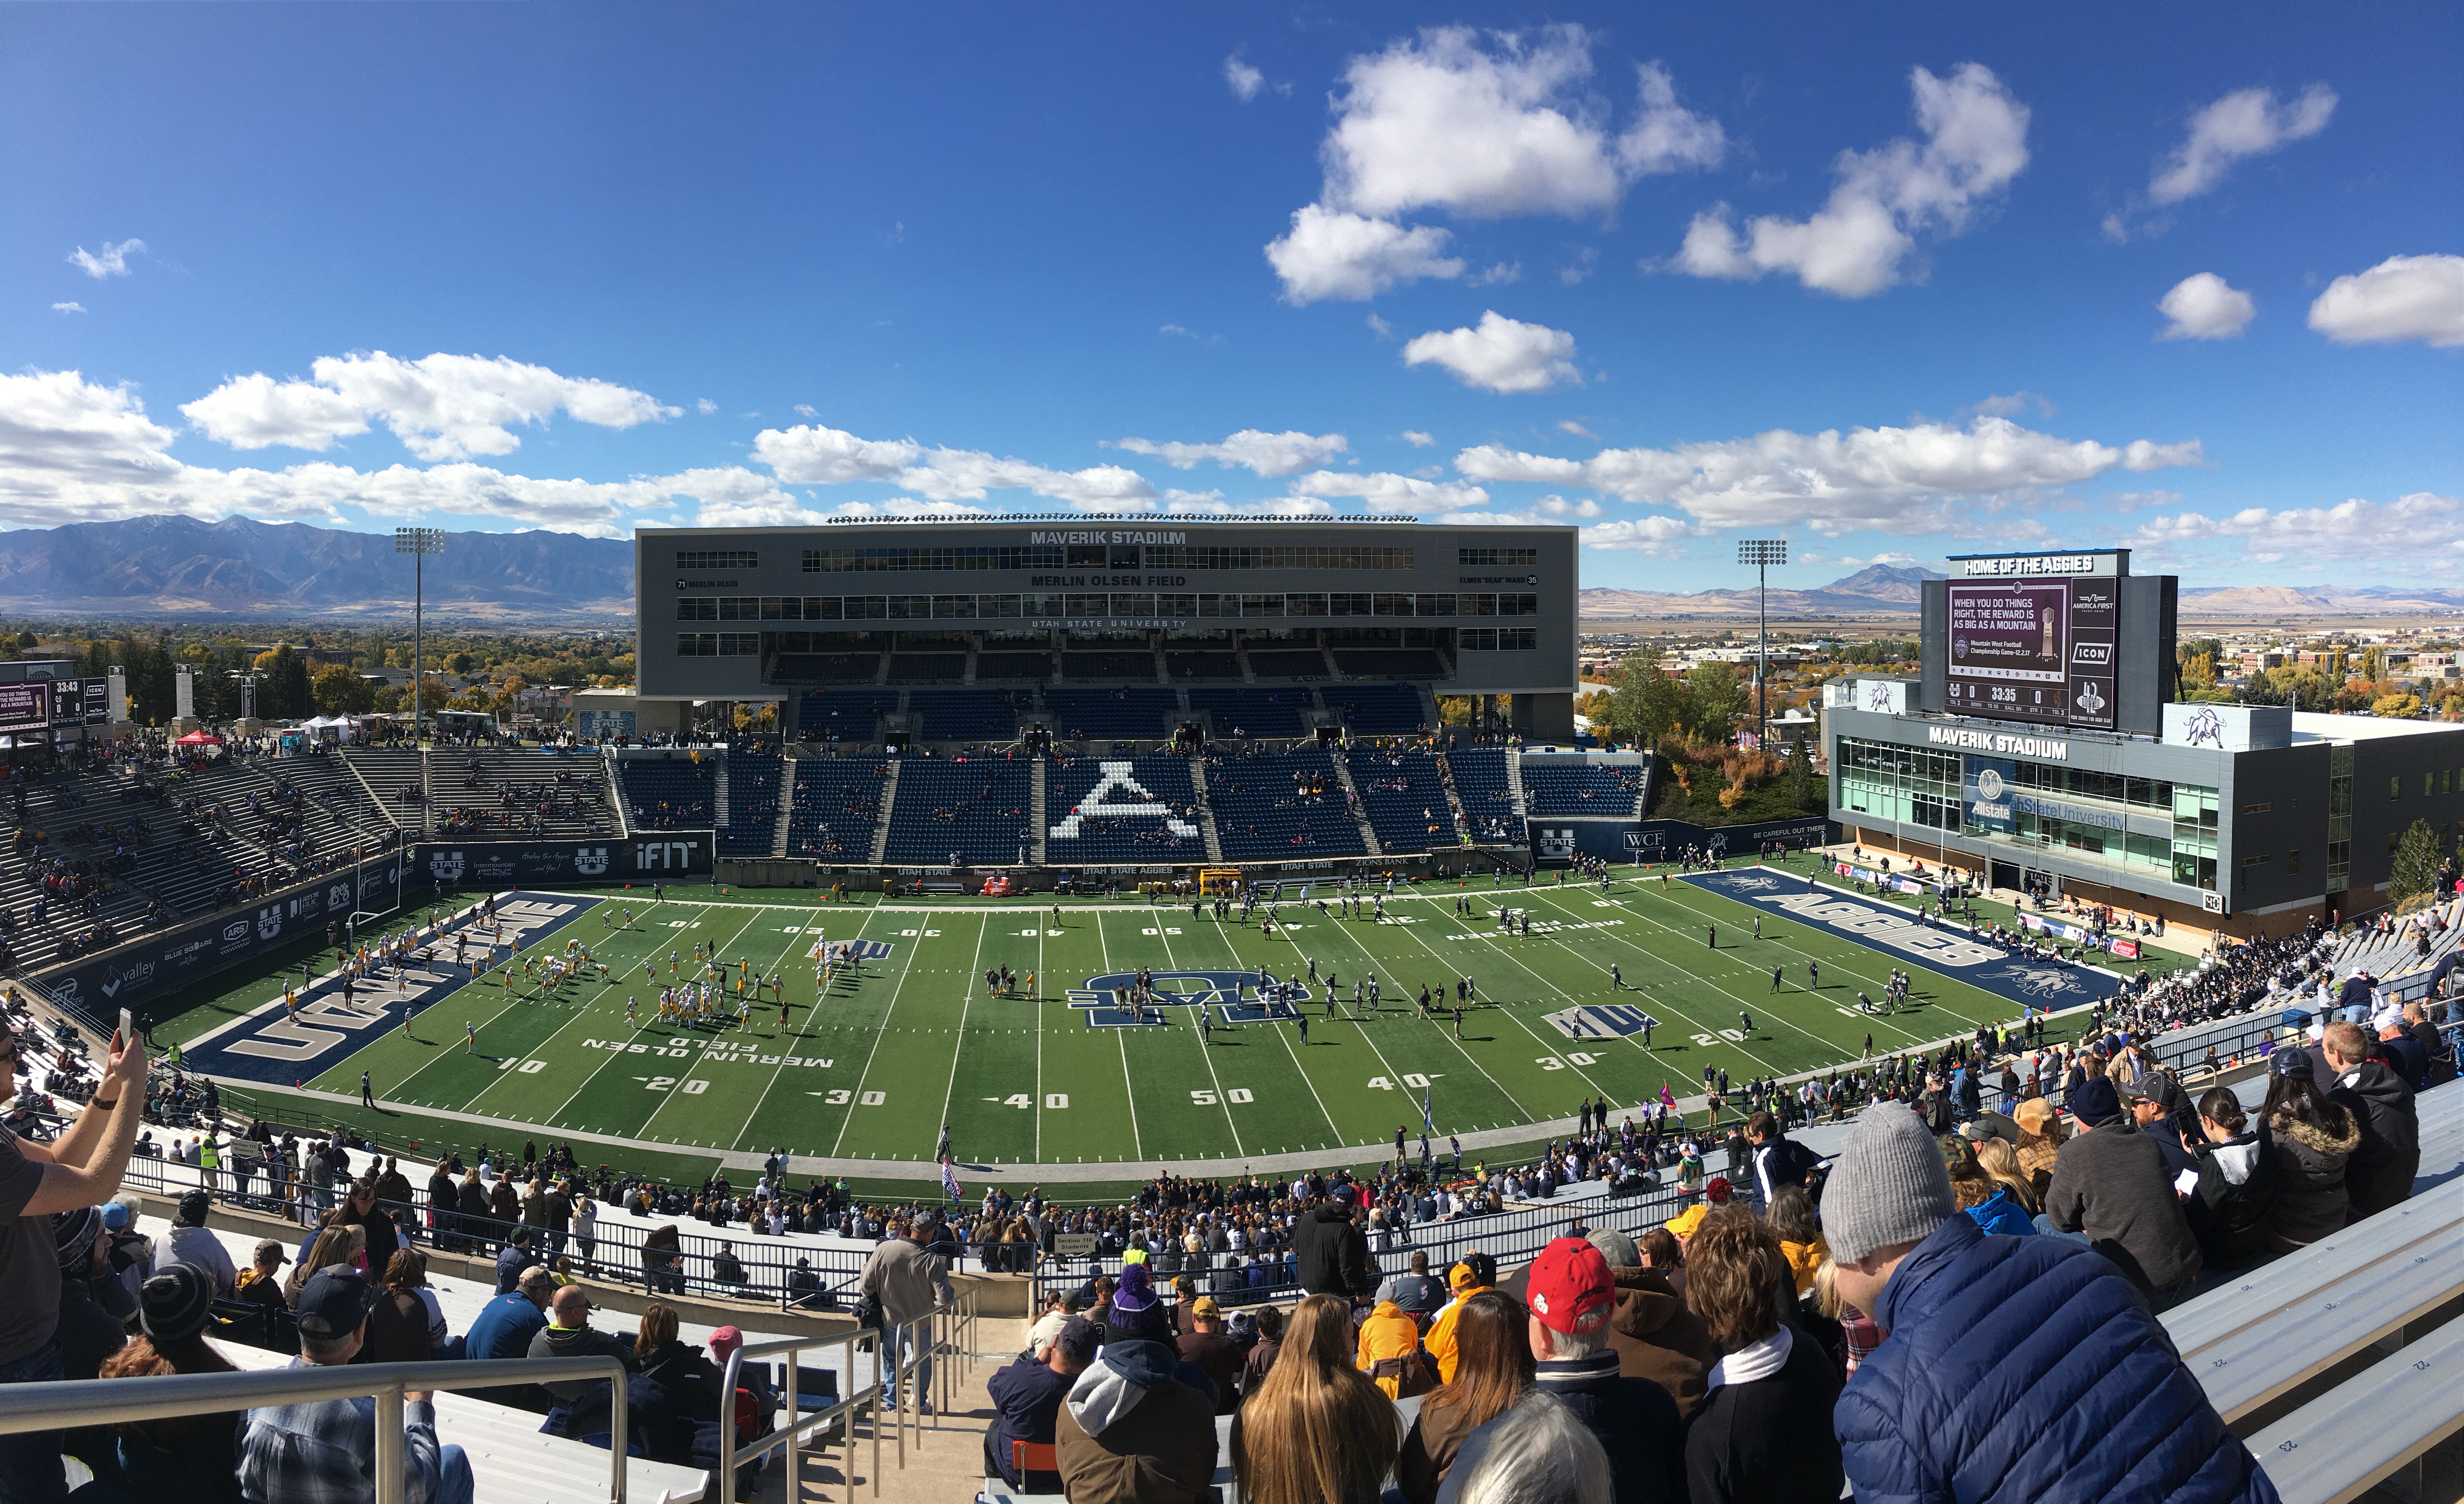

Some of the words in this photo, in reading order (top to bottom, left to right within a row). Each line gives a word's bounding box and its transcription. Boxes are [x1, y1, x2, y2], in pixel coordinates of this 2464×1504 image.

[1031, 531, 1107, 544] MAVERIK
[1112, 531, 1186, 544] STADIUM
[1965, 560, 2000, 574] HOME
[2000, 559, 2015, 573] OF
[2016, 558, 2043, 573] THE
[2043, 556, 2093, 572] AGGIES
[1032, 576, 1084, 586] MERLIN
[1091, 576, 1141, 586] OLSEN
[1148, 576, 1186, 586] FIELD
[1954, 599, 1975, 608] WHEN
[1977, 599, 1991, 608] YOU
[1993, 599, 2003, 607] DO
[2005, 599, 2033, 608] THINGS
[1954, 609, 1975, 619] RIGHT,
[1977, 610, 1991, 618] THE
[1992, 610, 2025, 619] REWARD
[2026, 610, 2034, 619] IS
[1954, 620, 1963, 629] AS
[1965, 620, 1977, 629] BIG
[1978, 621, 1988, 629] AS
[1990, 621, 1995, 629] A
[1997, 621, 2036, 630] MOUNTAIN
[2079, 648, 2105, 659] ICON
[57, 681, 78, 693] 33:43
[1970, 686, 1975, 698] 0
[1991, 687, 2016, 702] 33:35
[2035, 691, 2041, 704] 0
[56, 704, 61, 713] 0
[75, 703, 80, 711] 0
[592, 718, 624, 729] STATE
[1929, 726, 1994, 751] MAVERIK
[1996, 735, 2068, 760] STADIUM
[1972, 800, 2010, 819] Allstate
[1763, 829, 1791, 837] CAREFUL
[1540, 838, 1575, 847] STATE
[1626, 833, 1662, 847] WCF
[408, 849, 414, 859] 40
[522, 852, 541, 862] Healing
[553, 852, 570, 863] Aggies
[575, 855, 609, 866] STATE
[637, 842, 698, 870] iFIT
[430, 860, 466, 870] STATE
[1308, 861, 1333, 869] STATE
[302, 894, 313, 902] JACK'S
[328, 882, 350, 907] Lee's
[2206, 896, 2219, 910] 40
[258, 913, 282, 931] STATE
[227, 924, 245, 938] ARS
[1753, 893, 2009, 966] AGGIES
[2115, 940, 2135, 953] Gossner
[123, 961, 155, 982] valley
[580, 1037, 691, 1058] OLSEN
[668, 1037, 759, 1052] FIELD
[703, 1051, 834, 1068] MERLIN
[1535, 1052, 1598, 1072] 30
[1367, 1072, 1432, 1091] 40
[825, 1089, 887, 1106] 30
[1003, 1093, 1069, 1109] 40
[1189, 1088, 1255, 1106] 50
[2212, 1359, 2227, 1368] 22
[2413, 1360, 2430, 1371] 22
[2278, 1440, 2298, 1452] 23
